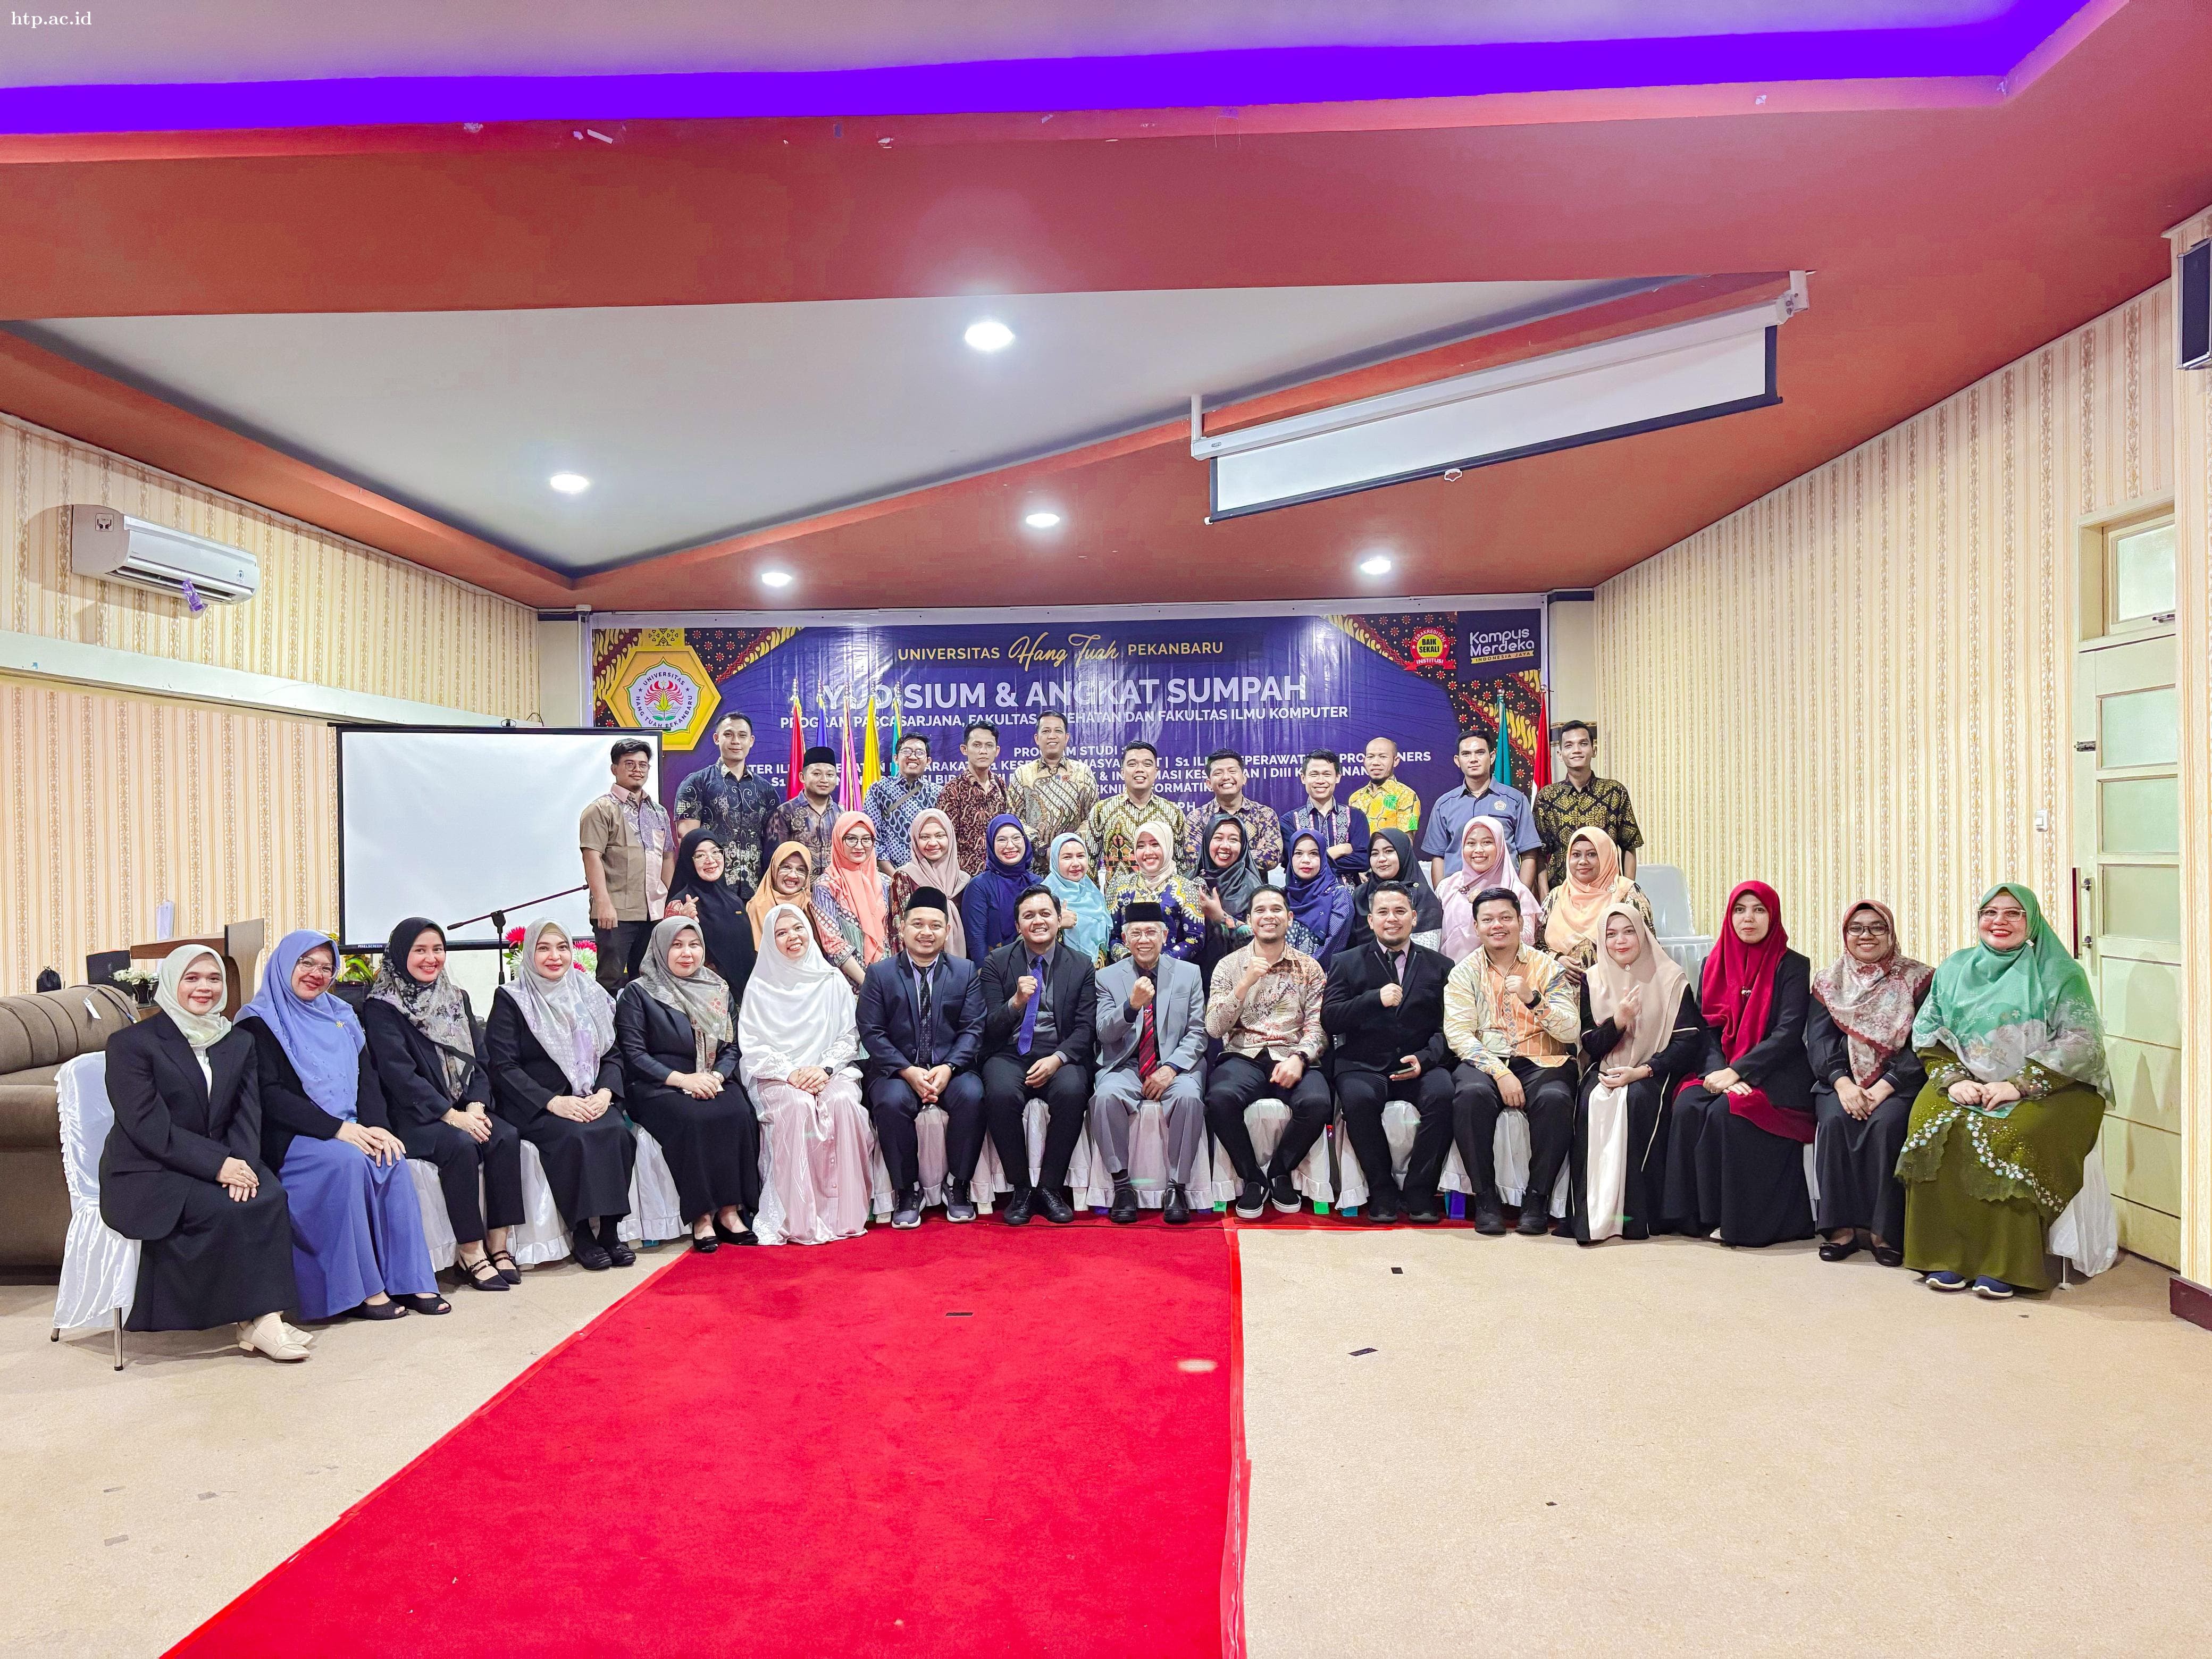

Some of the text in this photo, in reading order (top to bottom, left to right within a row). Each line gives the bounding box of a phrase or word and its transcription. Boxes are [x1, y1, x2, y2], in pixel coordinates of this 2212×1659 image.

[1413, 629, 1447, 643] TERAKREDITASI
[1469, 628, 1530, 645] Kampus
[898, 632, 1223, 672] UNIVERSITAS Hang Tuah PEKANBARU
[1470, 640, 1535, 657] Merdeka
[643, 672, 685, 686] UNIVERSITAS
[995, 682, 1019, 707] &
[1025, 679, 1160, 705] ANGKAT
[1167, 675, 1307, 703] SUMPAH
[636, 695, 693, 728] HANG TUAH PEKANBARU
[1125, 711, 1155, 722] DAN
[1159, 709, 1228, 721] FAKULTAS
[1231, 708, 1266, 720] ILMU
[1270, 706, 1348, 719] KOMPUTER
[1079, 745, 1118, 756] STUDI
[1175, 757, 1189, 766] S1
[772, 777, 786, 787] S1
[1099, 771, 1108, 781] &
[1270, 767, 1291, 778] DIII
